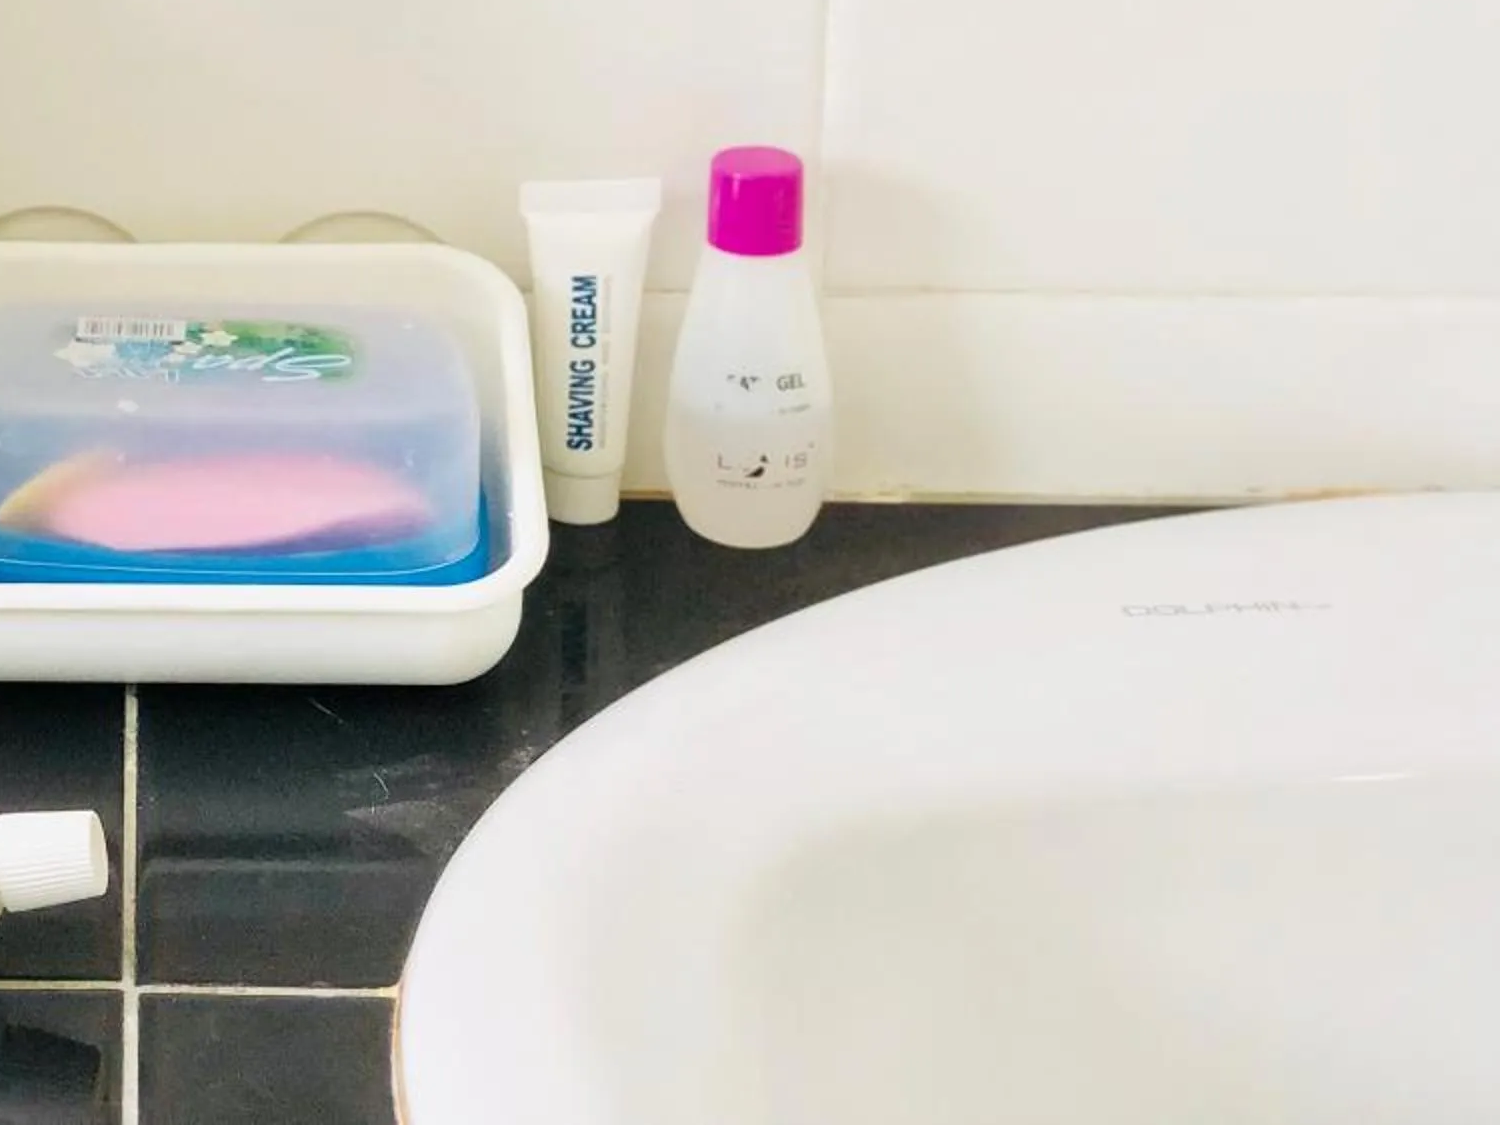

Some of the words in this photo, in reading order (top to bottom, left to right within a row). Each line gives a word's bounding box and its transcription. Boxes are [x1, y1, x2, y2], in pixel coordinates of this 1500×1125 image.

[571, 275, 597, 350] CREAM
[566, 357, 595, 452] SHAVING
[776, 372, 805, 392] GEL
